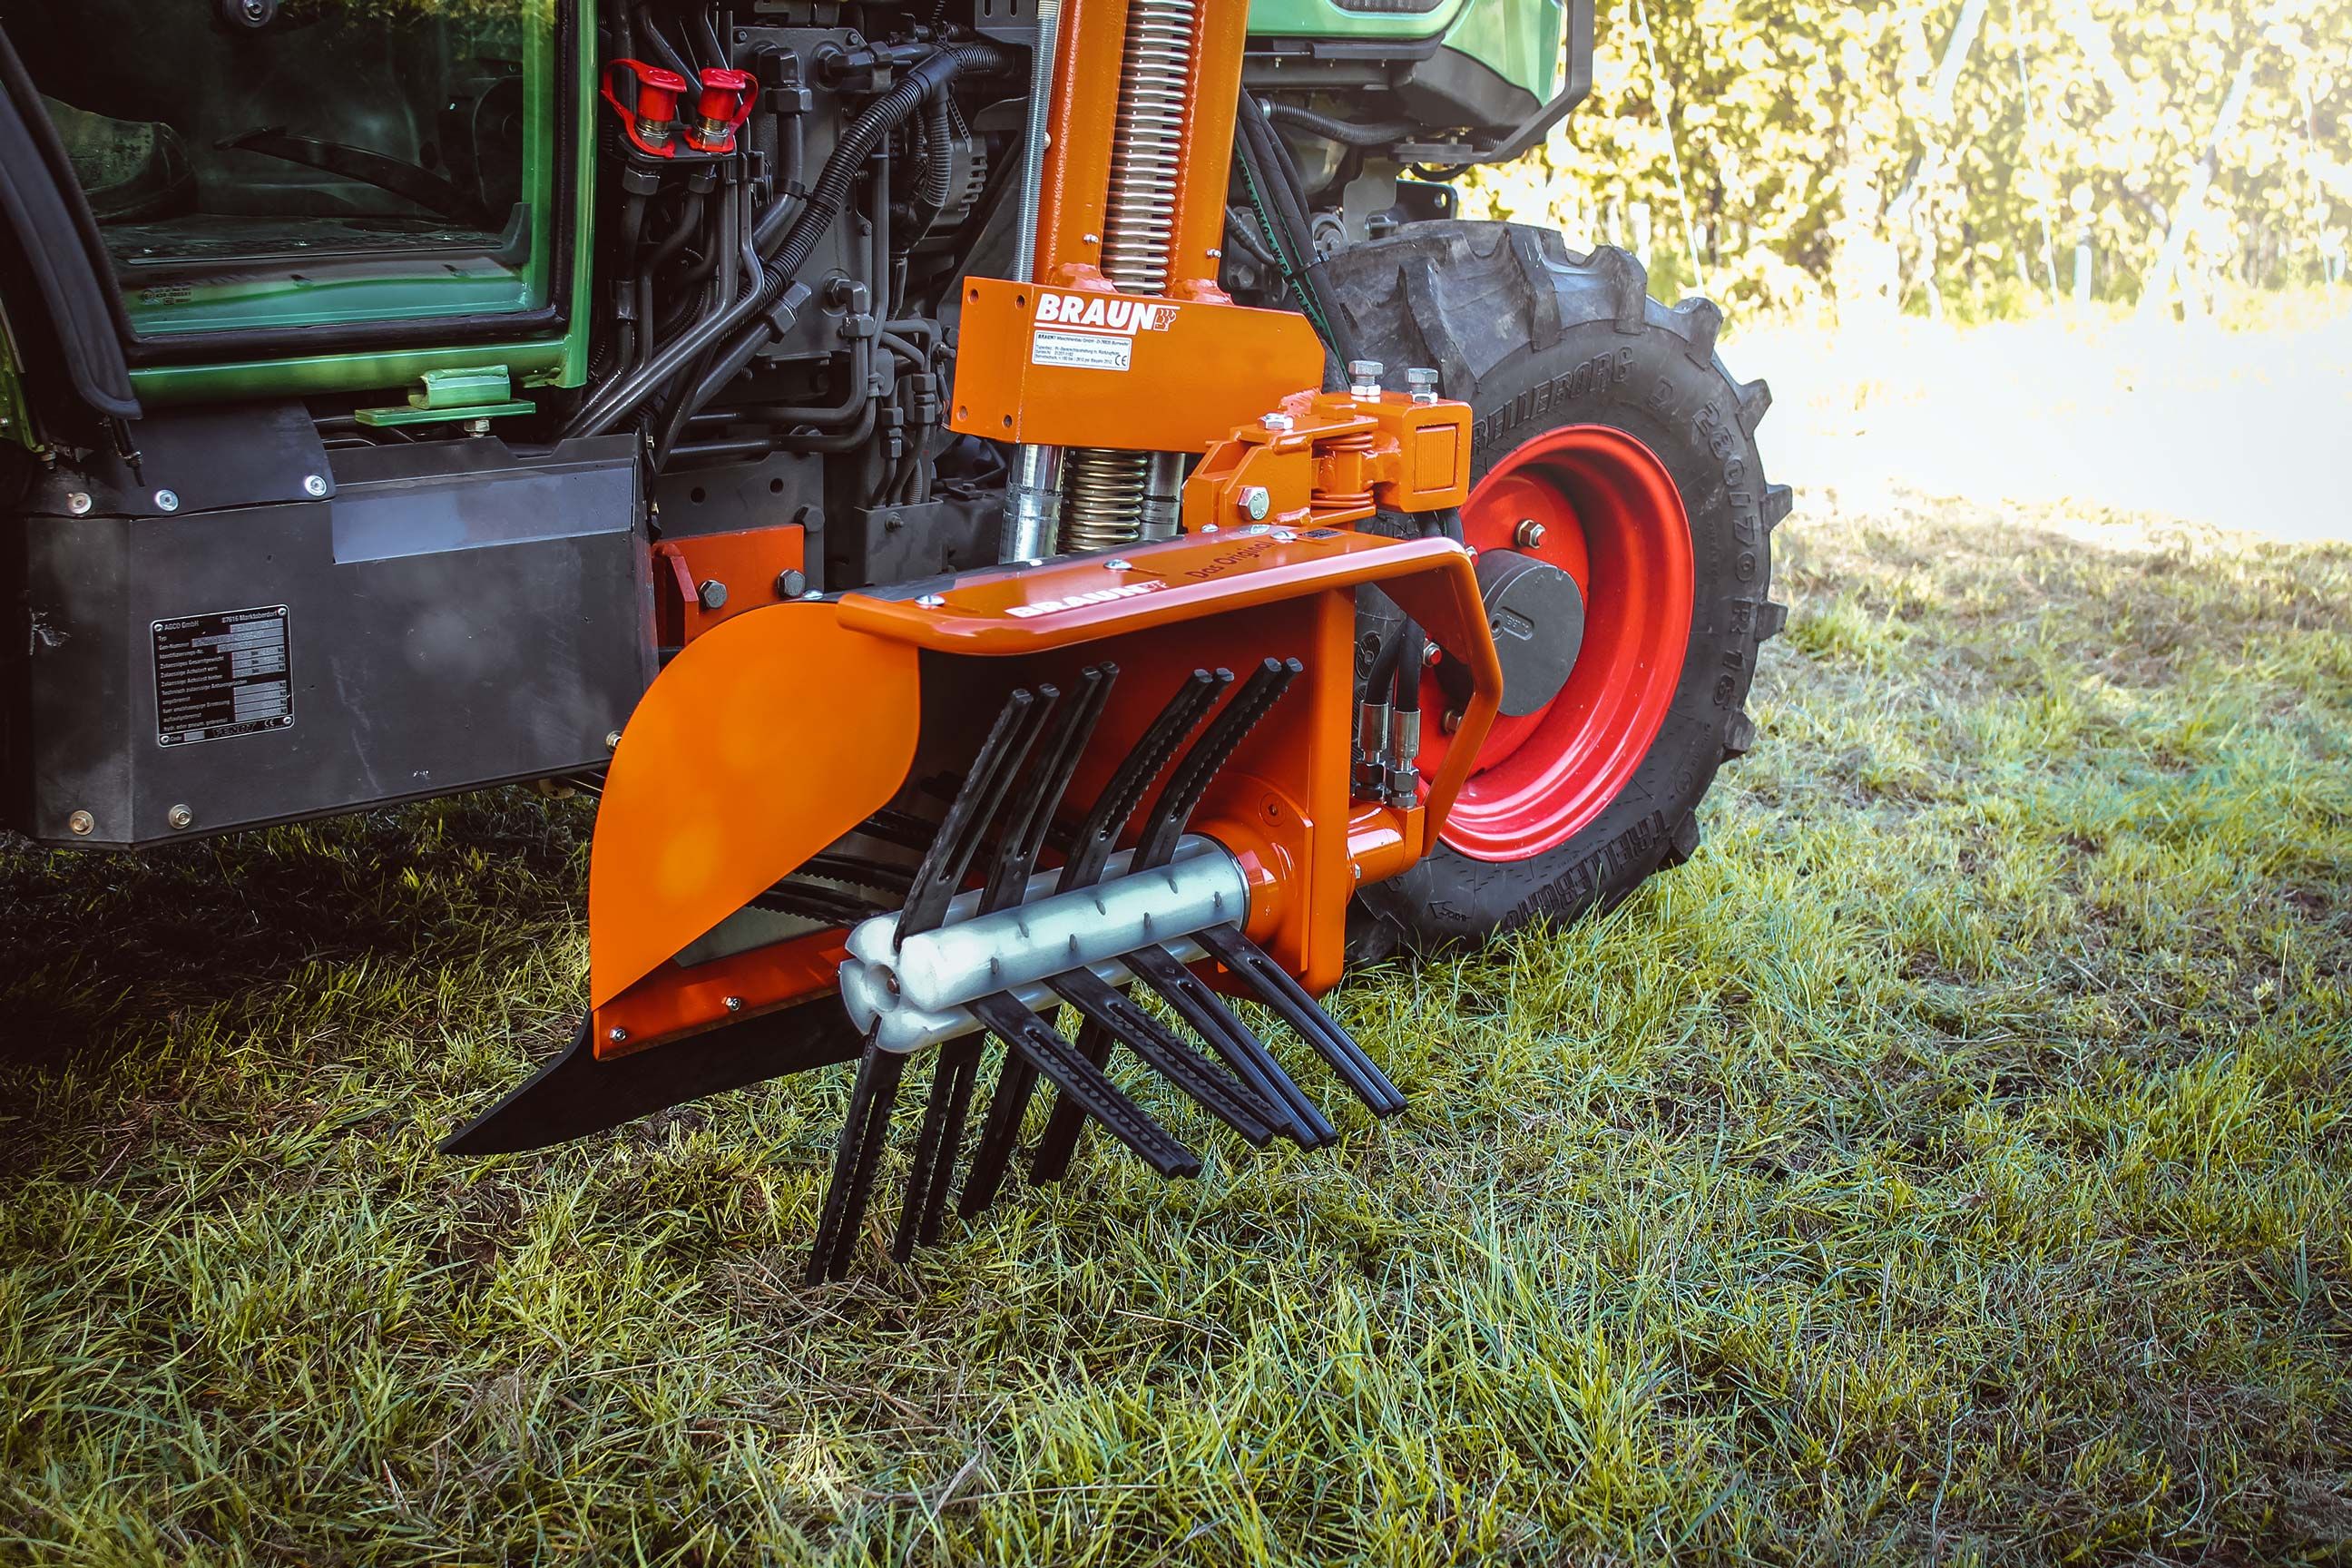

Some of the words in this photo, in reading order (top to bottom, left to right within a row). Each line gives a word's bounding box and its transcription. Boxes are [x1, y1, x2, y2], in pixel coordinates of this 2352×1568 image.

[1035, 293, 1158, 334] BRAUN
[1472, 347, 1634, 455] RELLEBORG
[1184, 566, 1226, 580] Das
[1225, 540, 1279, 566] Original
[1004, 582, 1149, 618] BRAUN
[212, 722, 256, 737] FENDT
